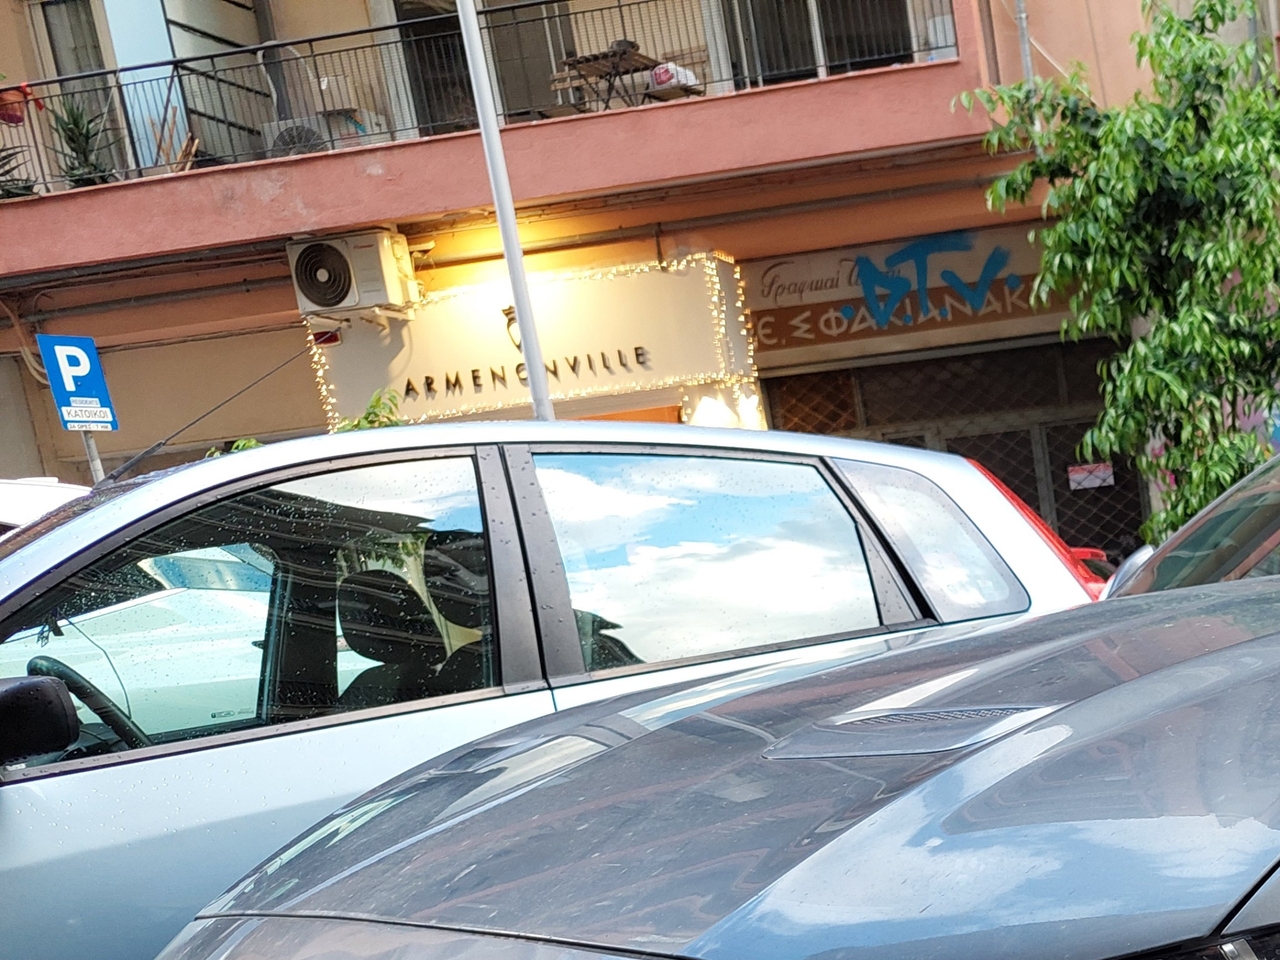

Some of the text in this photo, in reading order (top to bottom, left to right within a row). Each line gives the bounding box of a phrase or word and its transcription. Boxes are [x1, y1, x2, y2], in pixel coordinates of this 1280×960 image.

[53, 345, 91, 392] P
[404, 346, 648, 397] ARMENONVILLE
[65, 409, 109, 419] ΚΑΤΟΙΚΟΙ
